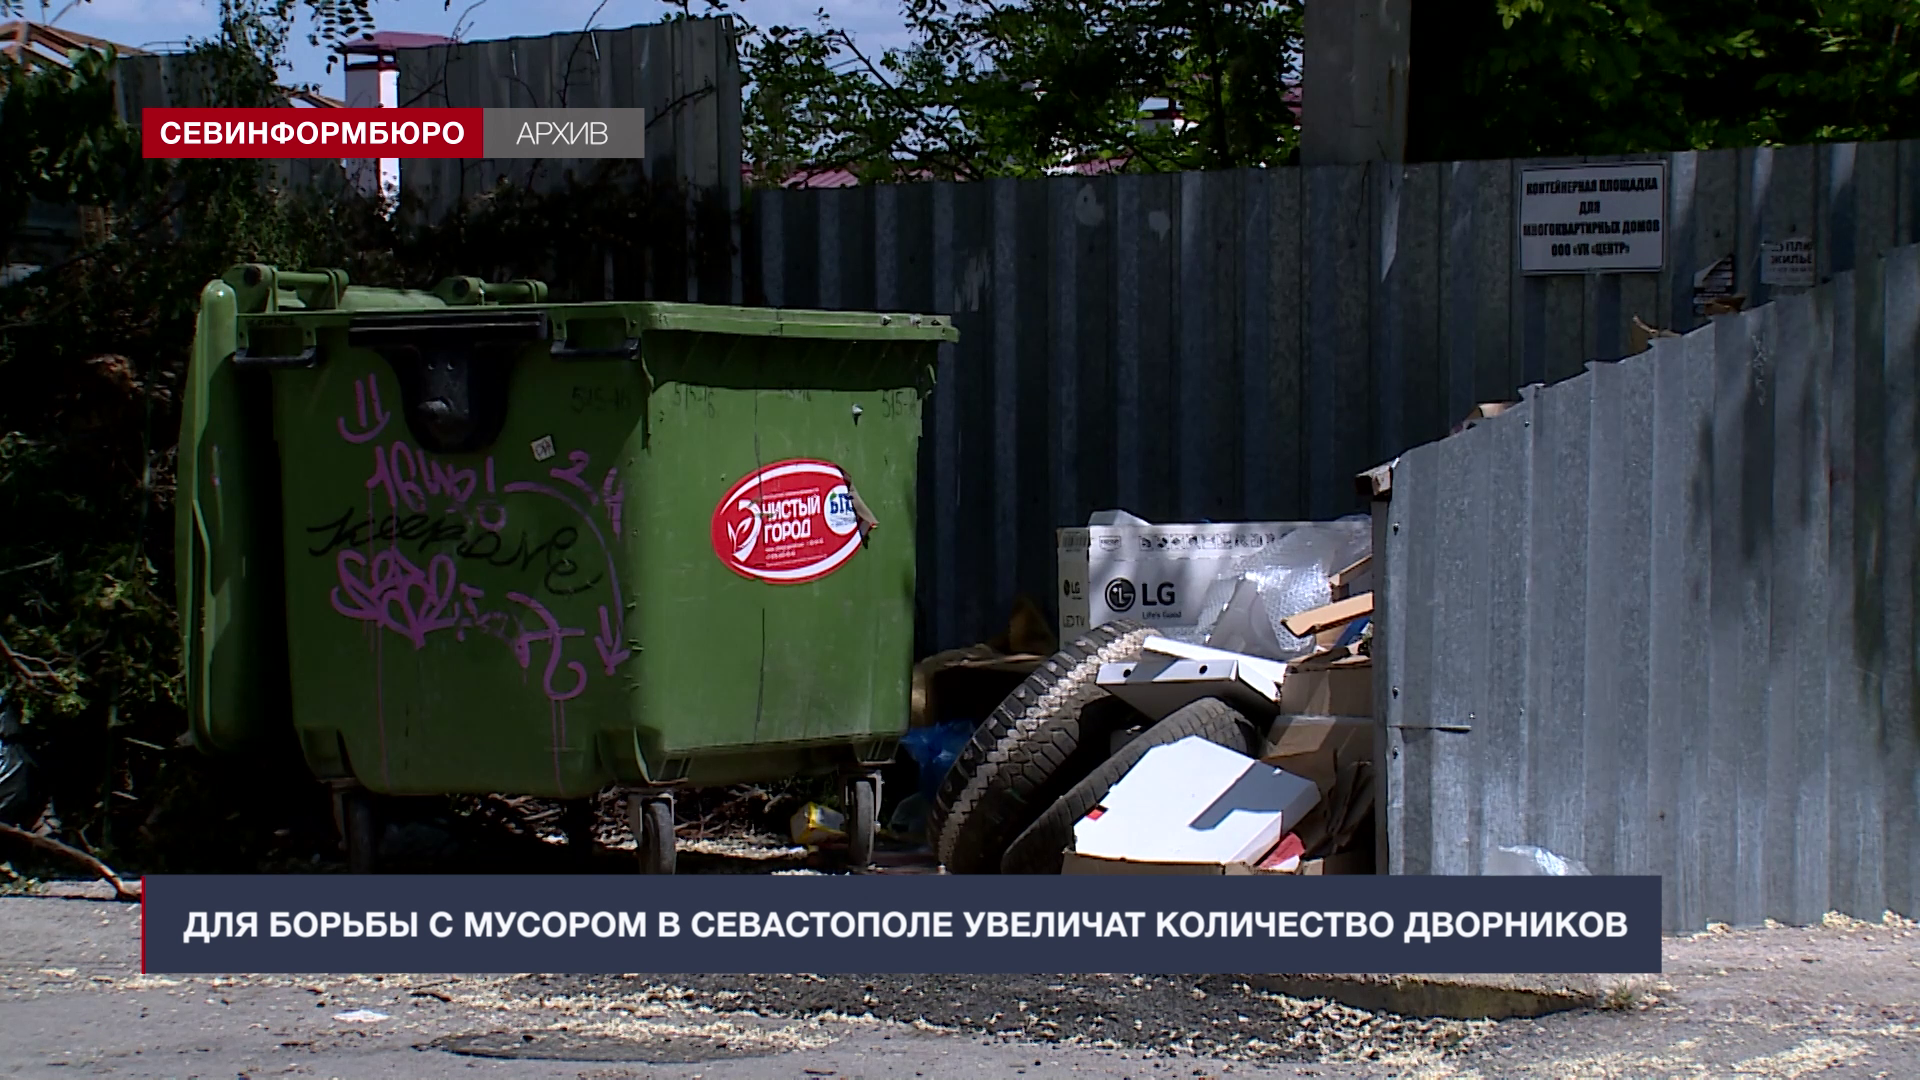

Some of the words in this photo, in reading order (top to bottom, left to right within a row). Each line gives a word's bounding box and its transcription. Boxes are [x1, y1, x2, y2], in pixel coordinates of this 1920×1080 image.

[1526, 180, 1597, 195] КОНТЕЙНЕРНАЯ
[1599, 177, 1658, 193] ПЛОЩАДКА
[1579, 201, 1600, 215] ДЛЯ
[1523, 221, 1620, 236] МНОГОКВАРТИРНЫХ
[1623, 219, 1660, 235] ДОМОВ
[1551, 243, 1571, 256] ООО
[762, 494, 821, 522] ЧИСТЫЙ
[764, 518, 812, 545] ГОРОД
[1142, 582, 1175, 606] LG
[1076, 615, 1085, 626] TV
